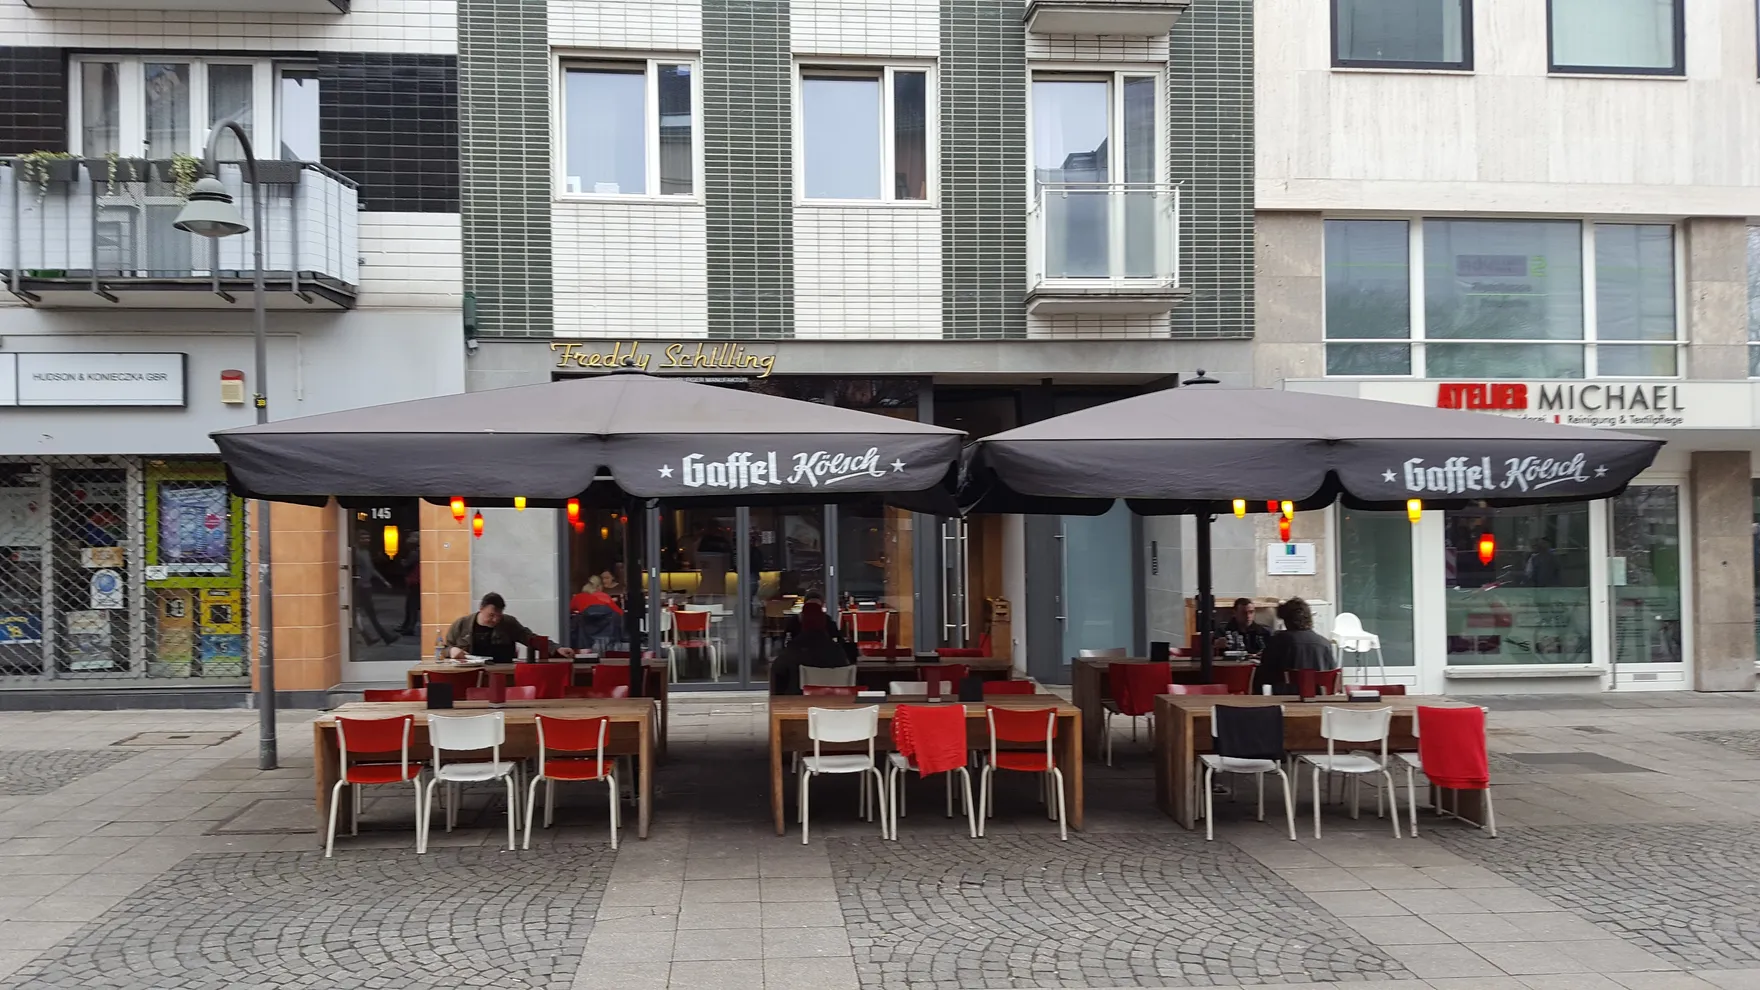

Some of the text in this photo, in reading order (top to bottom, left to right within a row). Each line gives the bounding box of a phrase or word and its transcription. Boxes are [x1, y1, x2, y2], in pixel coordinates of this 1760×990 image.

[550, 341, 777, 378] Freddy Schilling
[33, 372, 76, 382] HUDSON
[78, 373, 85, 382] &
[87, 372, 145, 382] KONIECZKA
[1437, 383, 1685, 411] ATELIER MICHAEL
[1568, 414, 1684, 427] Reinigung & Textilpflege
[682, 447, 887, 490] Gaffel Kölsch
[1403, 452, 1591, 495] Gaffel Kölsch
[371, 507, 392, 519] 145
